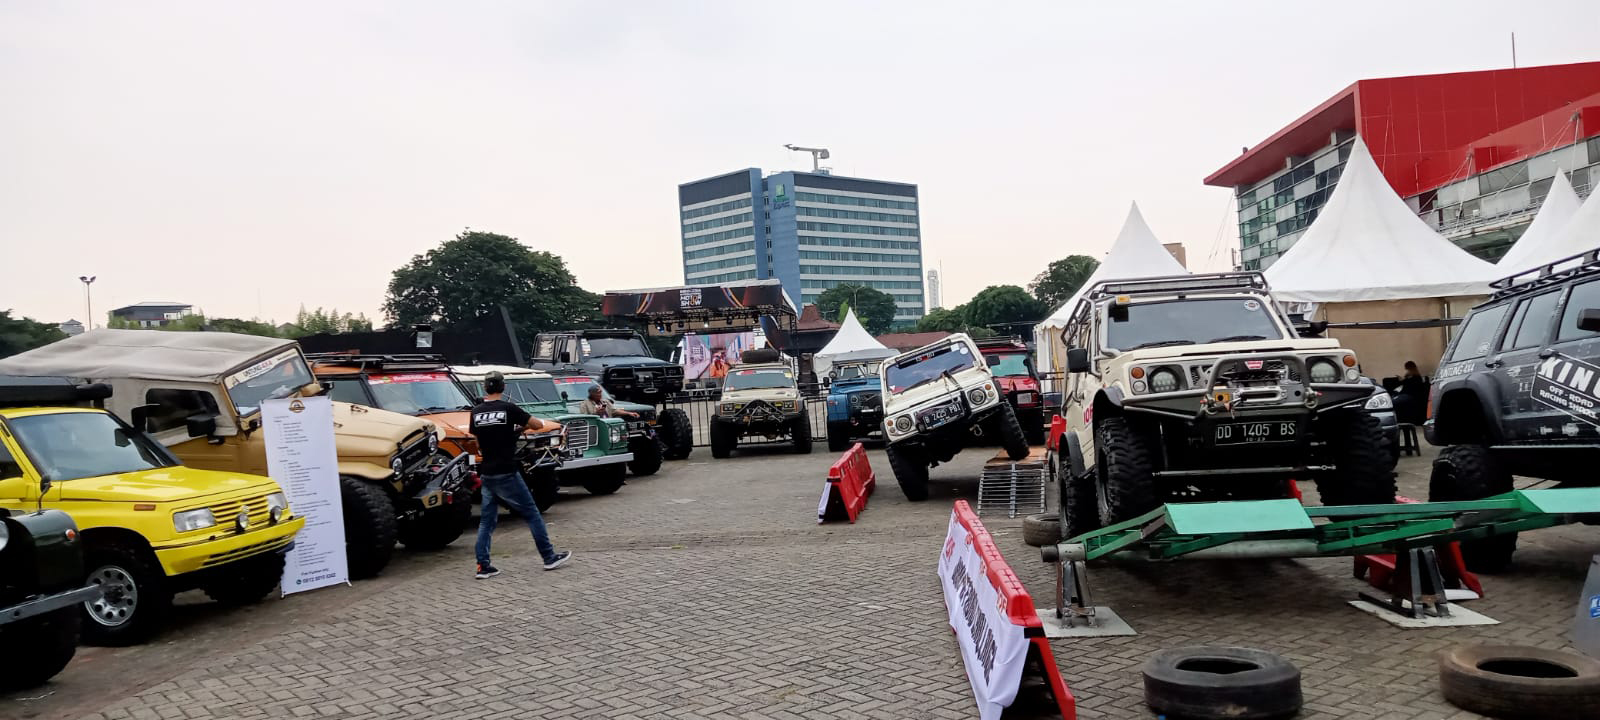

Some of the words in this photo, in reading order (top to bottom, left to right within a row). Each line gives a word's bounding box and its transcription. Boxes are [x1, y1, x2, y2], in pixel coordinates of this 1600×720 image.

[1540, 389, 1568, 406] RACING
[1549, 385, 1564, 396] OFF
[1569, 393, 1594, 408] ROAD
[475, 412, 505, 421] KING
[1217, 425, 1232, 439] DD
[1242, 423, 1271, 437] 1405
[1280, 423, 1296, 436] BS
